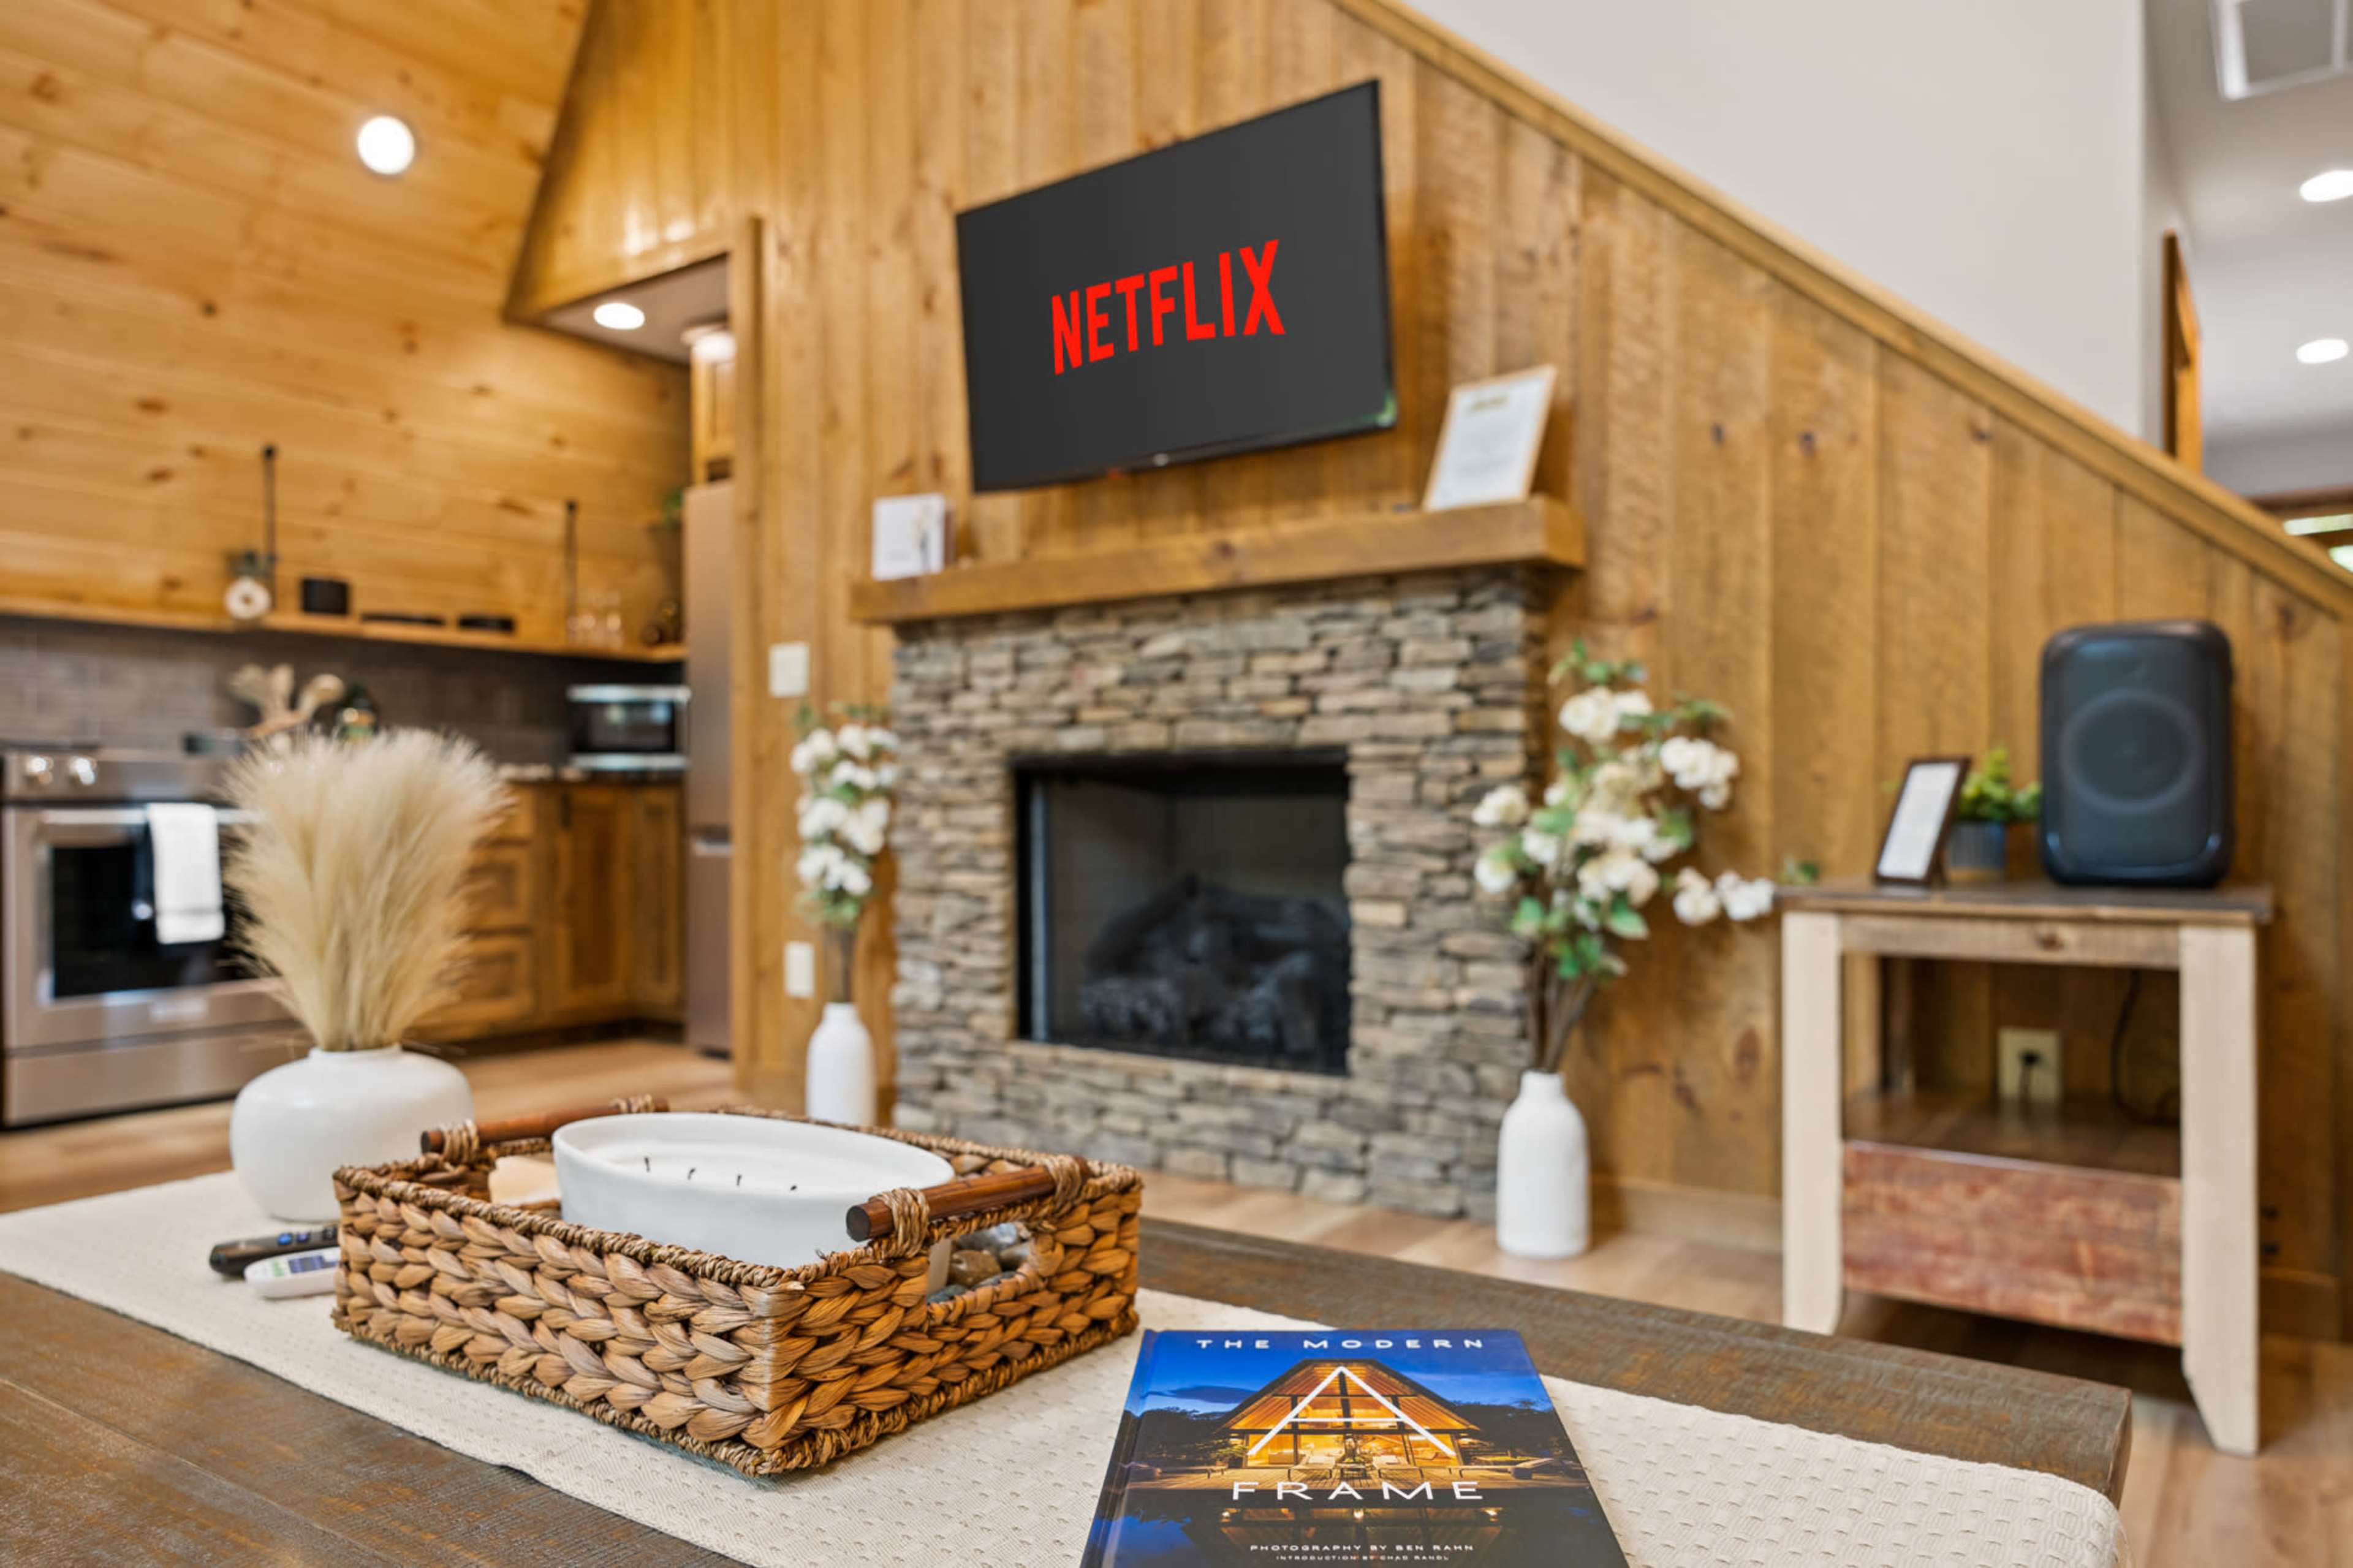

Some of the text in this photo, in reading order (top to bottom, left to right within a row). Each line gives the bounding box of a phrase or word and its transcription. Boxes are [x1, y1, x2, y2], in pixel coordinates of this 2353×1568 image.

[1051, 239, 1286, 375] NETFLIX
[1197, 1339, 1483, 1349] THE MODERN
[1246, 1366, 1457, 1456] A
[1232, 1481, 1483, 1501] FRAME
